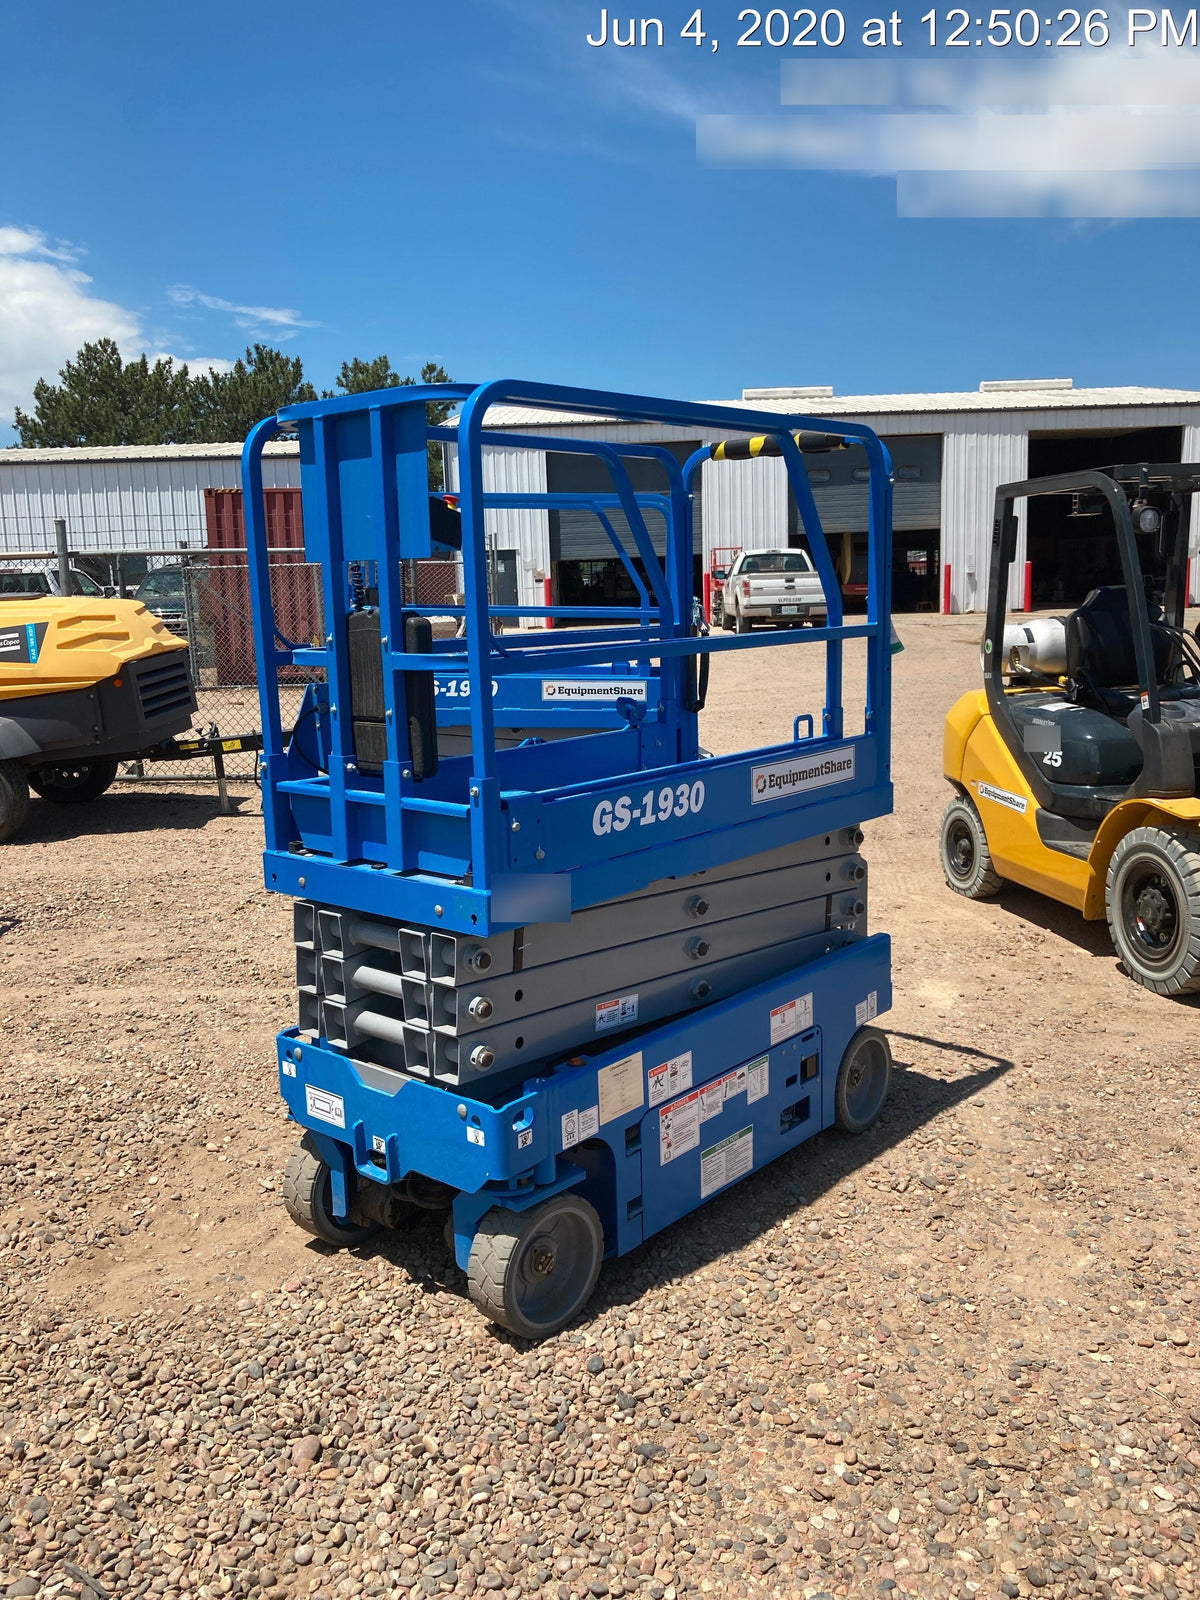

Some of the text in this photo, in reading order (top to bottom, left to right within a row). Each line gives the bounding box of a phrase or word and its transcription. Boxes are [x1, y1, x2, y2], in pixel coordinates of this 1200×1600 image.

[557, 685, 644, 697] EquipmentShare
[1043, 750, 1063, 767] 25
[768, 759, 852, 789] EquipmentShare
[592, 780, 705, 836] GS-1930
[984, 787, 1025, 809] EquipmentShare
